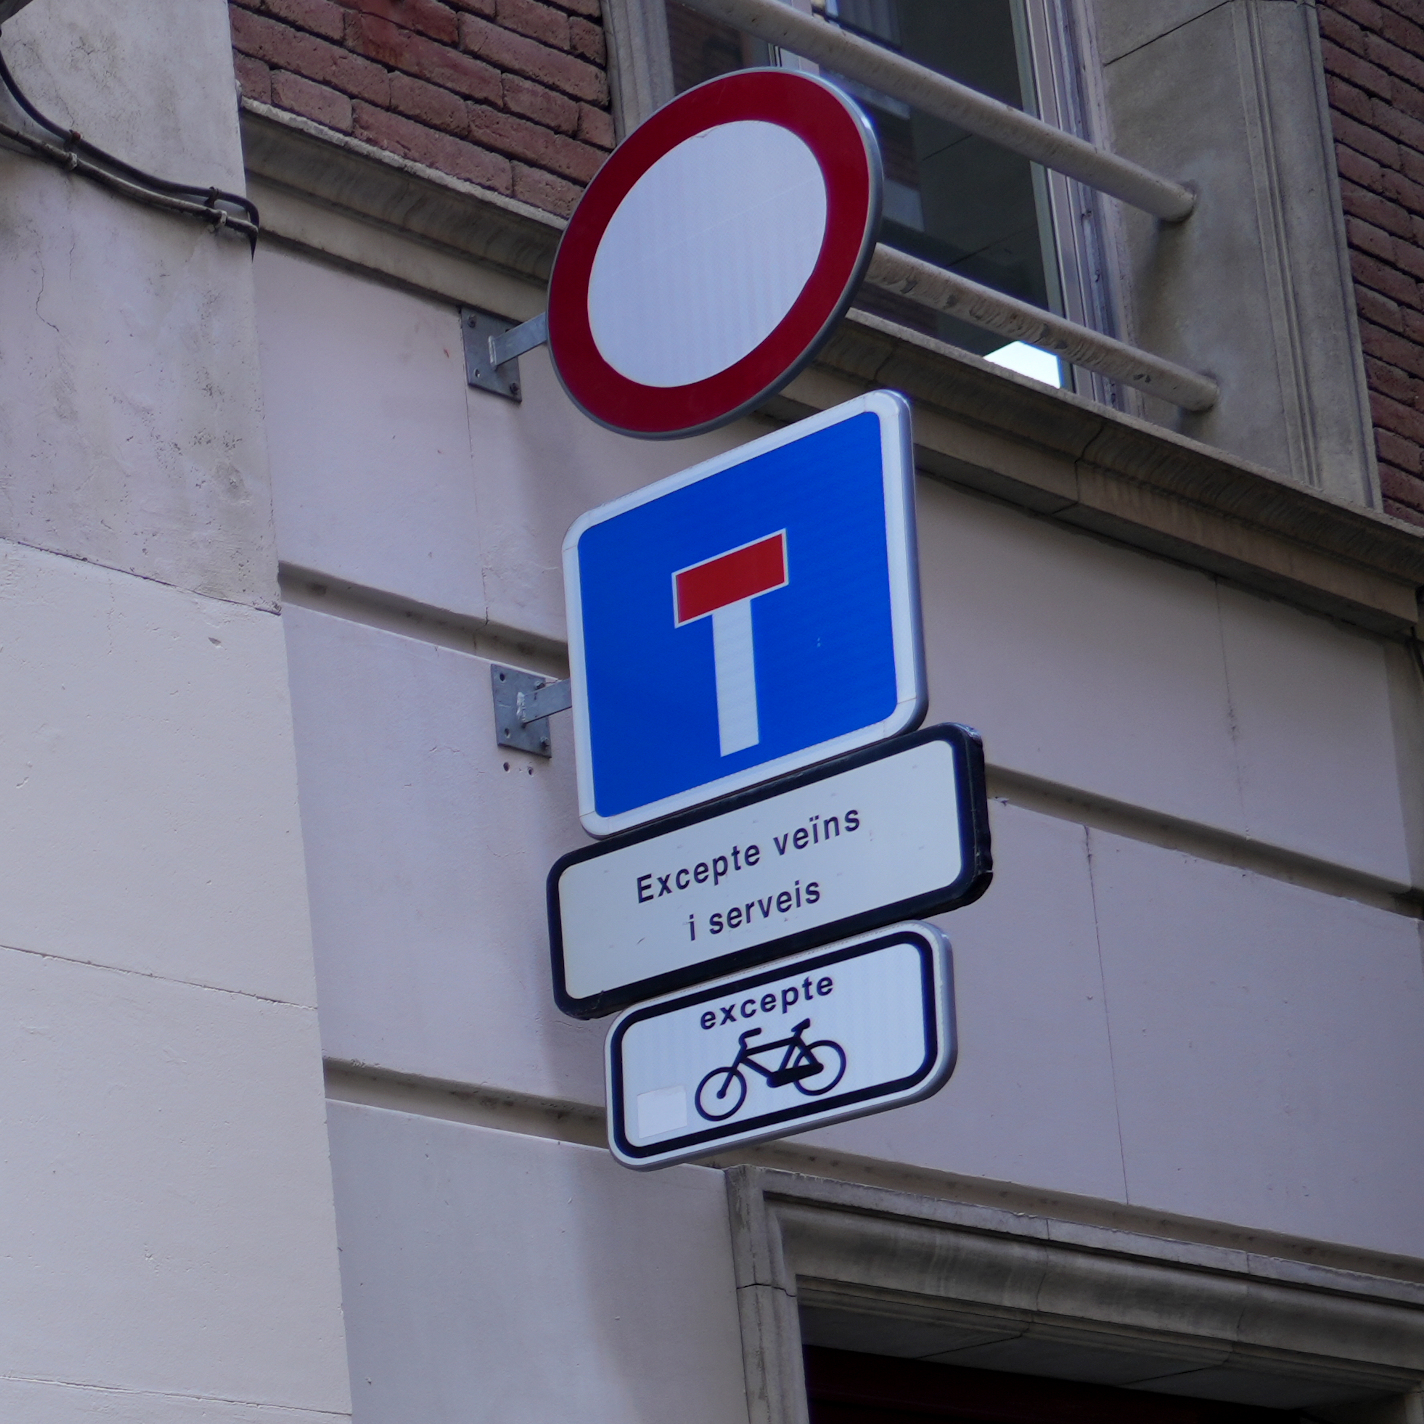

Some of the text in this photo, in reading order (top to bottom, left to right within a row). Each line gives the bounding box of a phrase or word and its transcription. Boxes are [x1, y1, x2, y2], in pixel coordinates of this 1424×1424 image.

[636, 808, 861, 904] Excepte veïns
[689, 880, 821, 942] i serveis
[699, 976, 835, 1031] excepte
